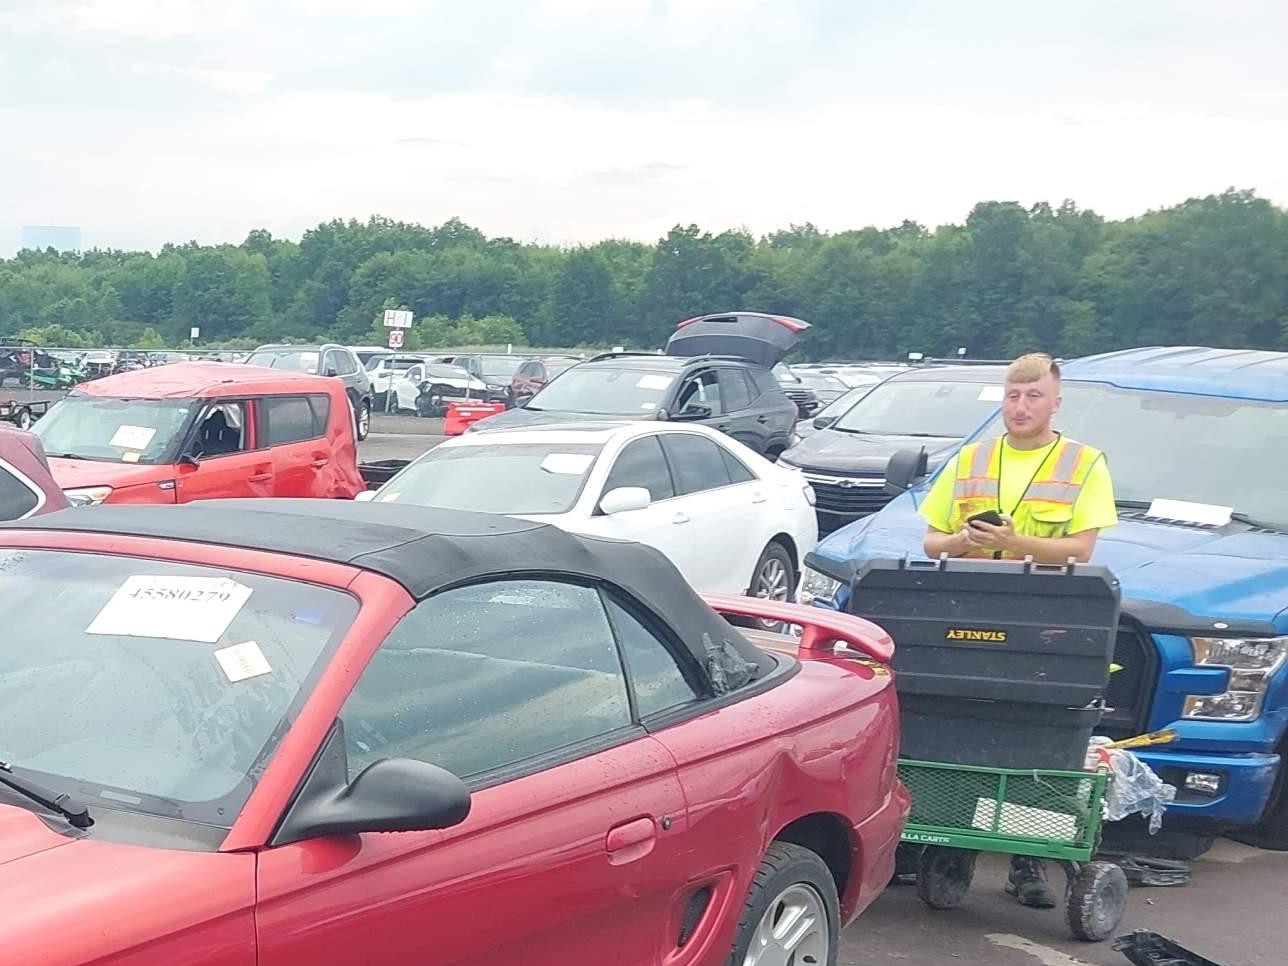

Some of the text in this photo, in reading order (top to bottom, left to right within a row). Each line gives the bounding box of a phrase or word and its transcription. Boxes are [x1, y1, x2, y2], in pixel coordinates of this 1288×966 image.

[387, 311, 396, 325] H
[128, 587, 231, 602] 45580279
[946, 629, 1007, 641] STANLEY
[901, 832, 919, 840] ILLA
